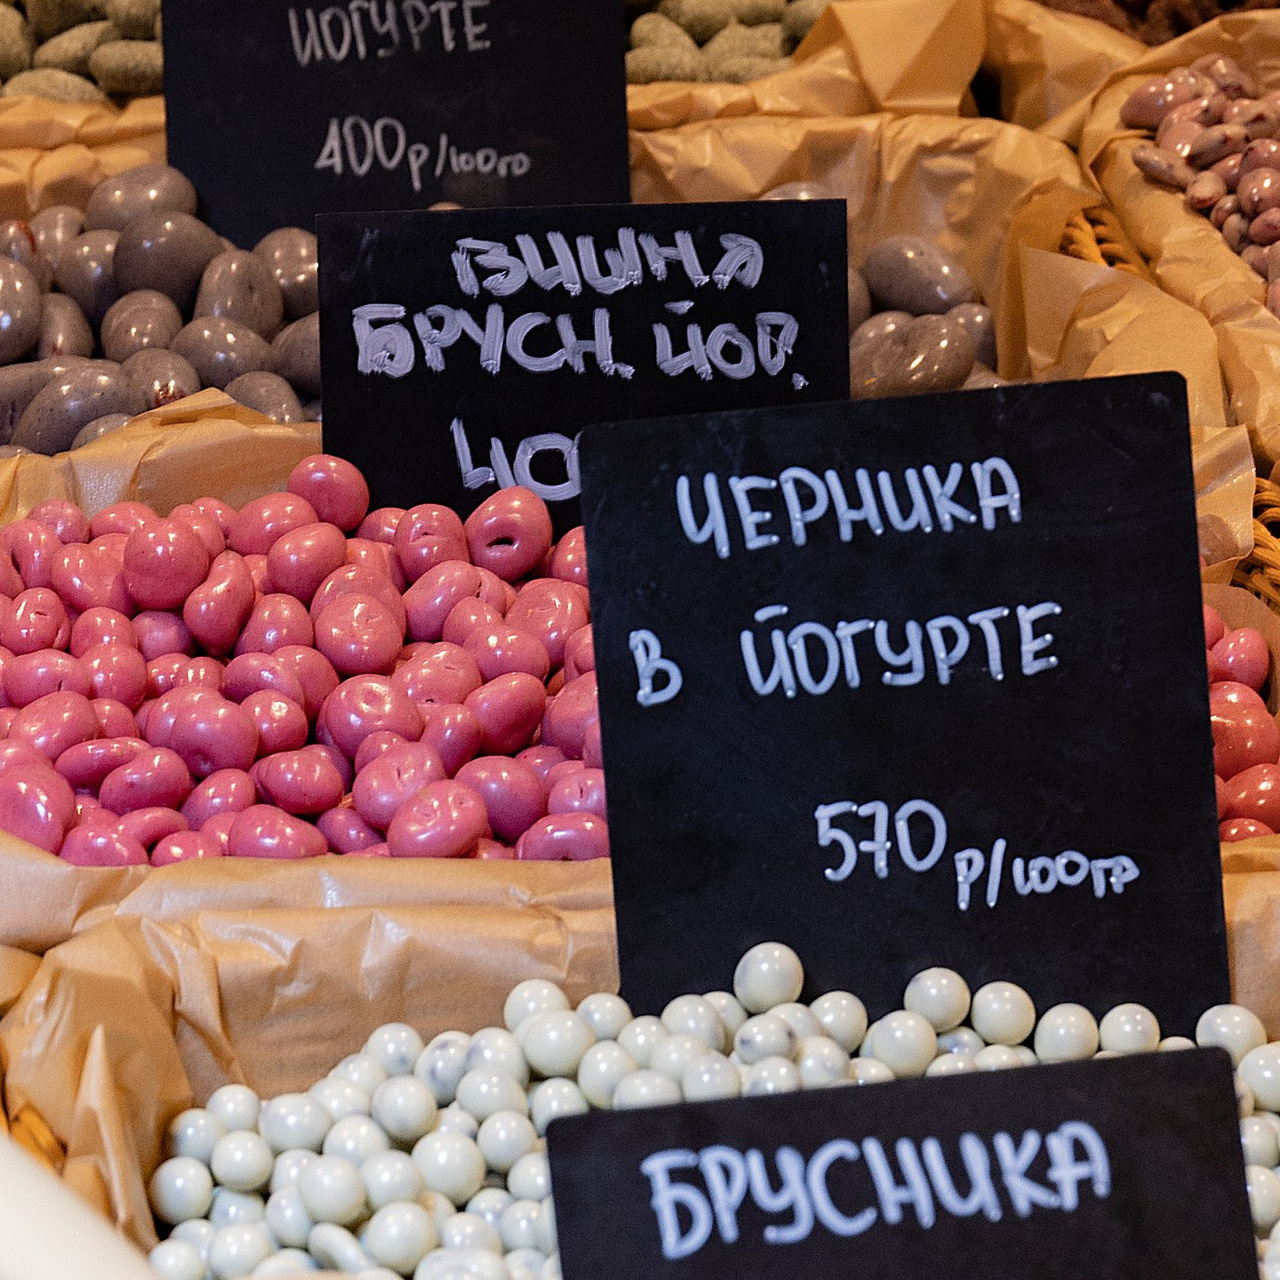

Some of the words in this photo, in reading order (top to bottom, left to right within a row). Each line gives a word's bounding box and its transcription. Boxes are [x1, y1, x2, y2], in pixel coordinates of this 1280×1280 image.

[451, 228, 763, 296] ВИШНЯ
[352, 303, 635, 379] БРУСН.
[677, 458, 1020, 558] ЧЕРНИКА
[629, 630, 682, 705] В
[741, 602, 1062, 697] ЙОГУРТЕ
[641, 1122, 1109, 1258] БРУСНИКА
